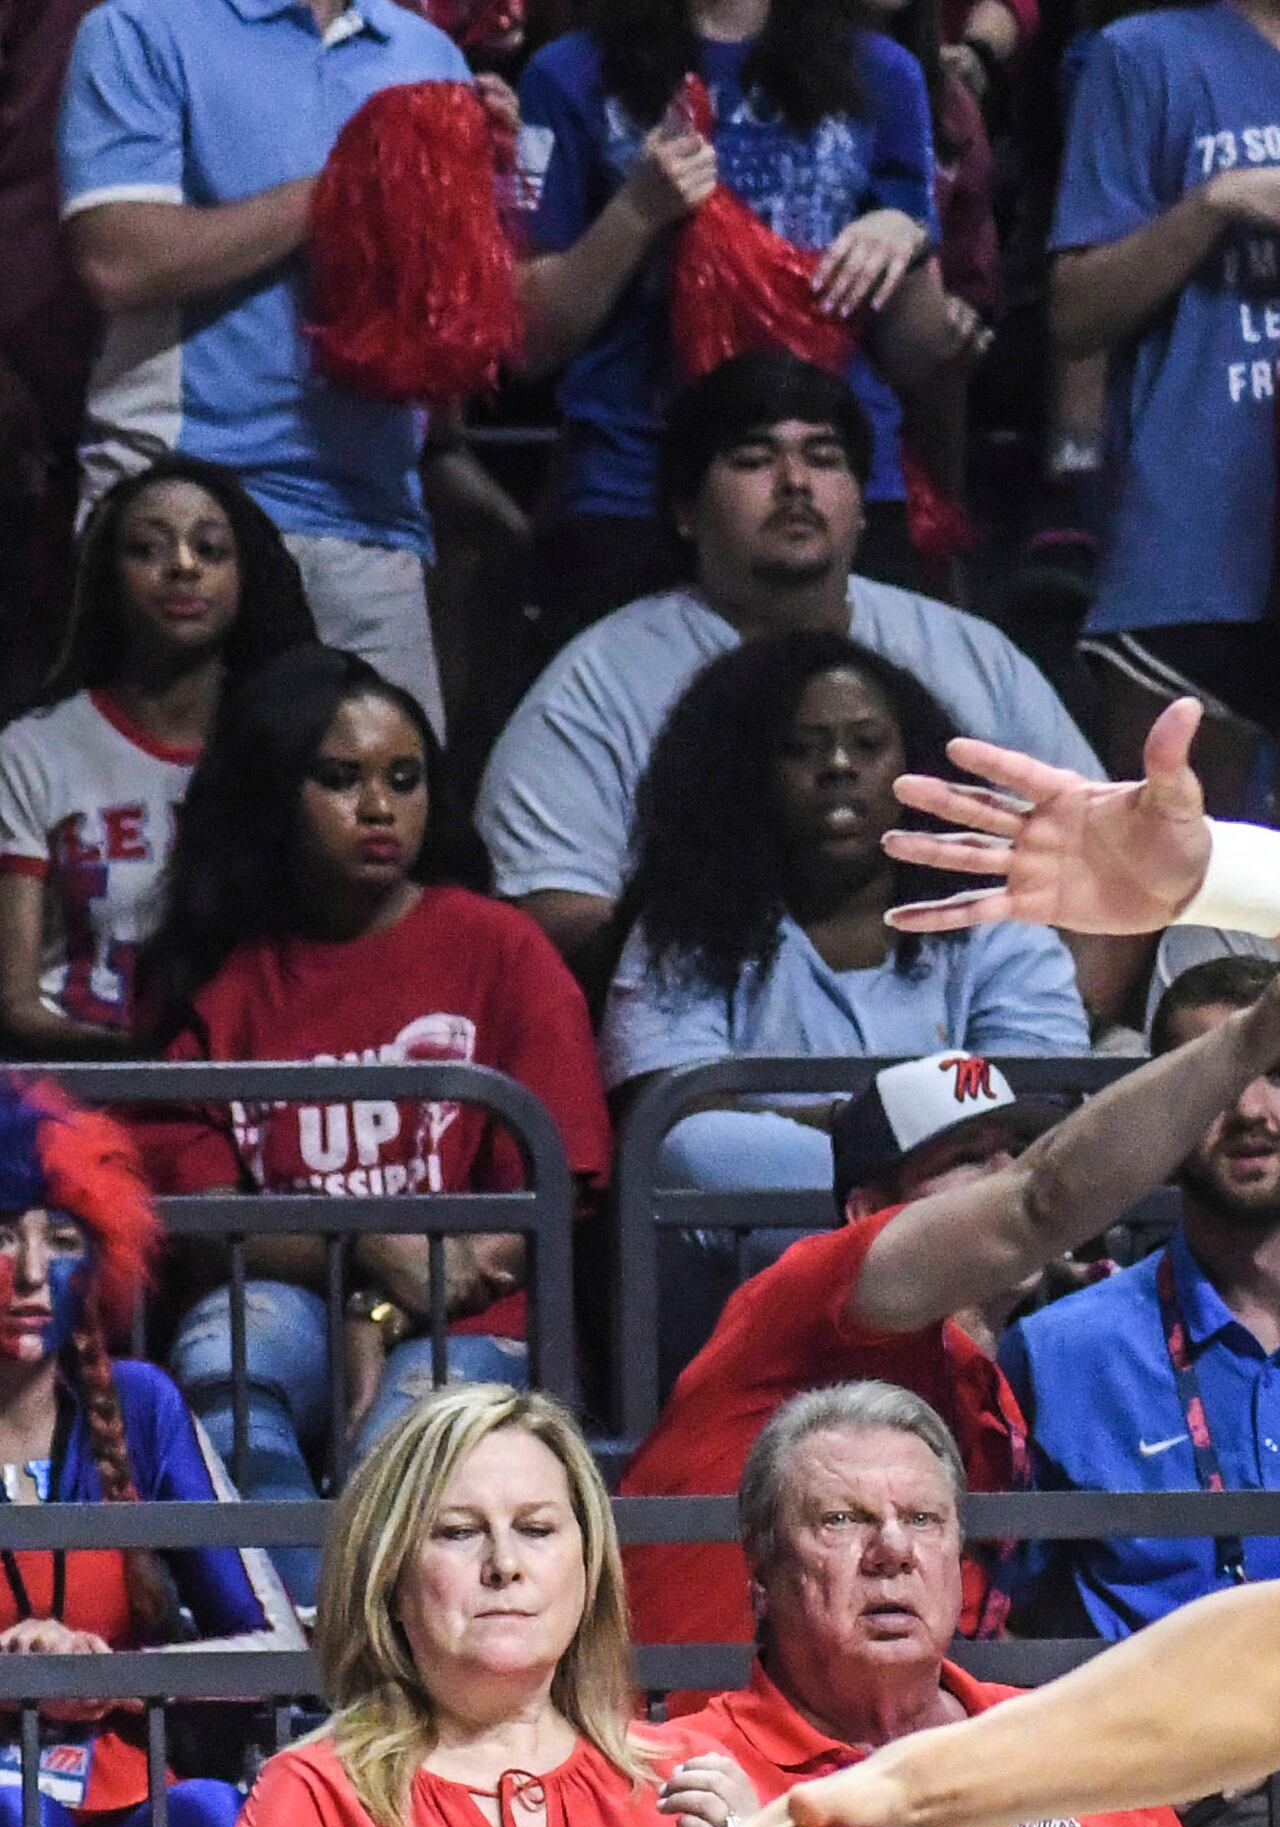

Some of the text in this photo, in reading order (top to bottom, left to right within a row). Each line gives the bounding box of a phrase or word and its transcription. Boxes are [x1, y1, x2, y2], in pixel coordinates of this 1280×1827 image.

[1197, 131, 1238, 176] 73
[938, 1055, 998, 1104] M
[298, 1099, 400, 1172] UP
